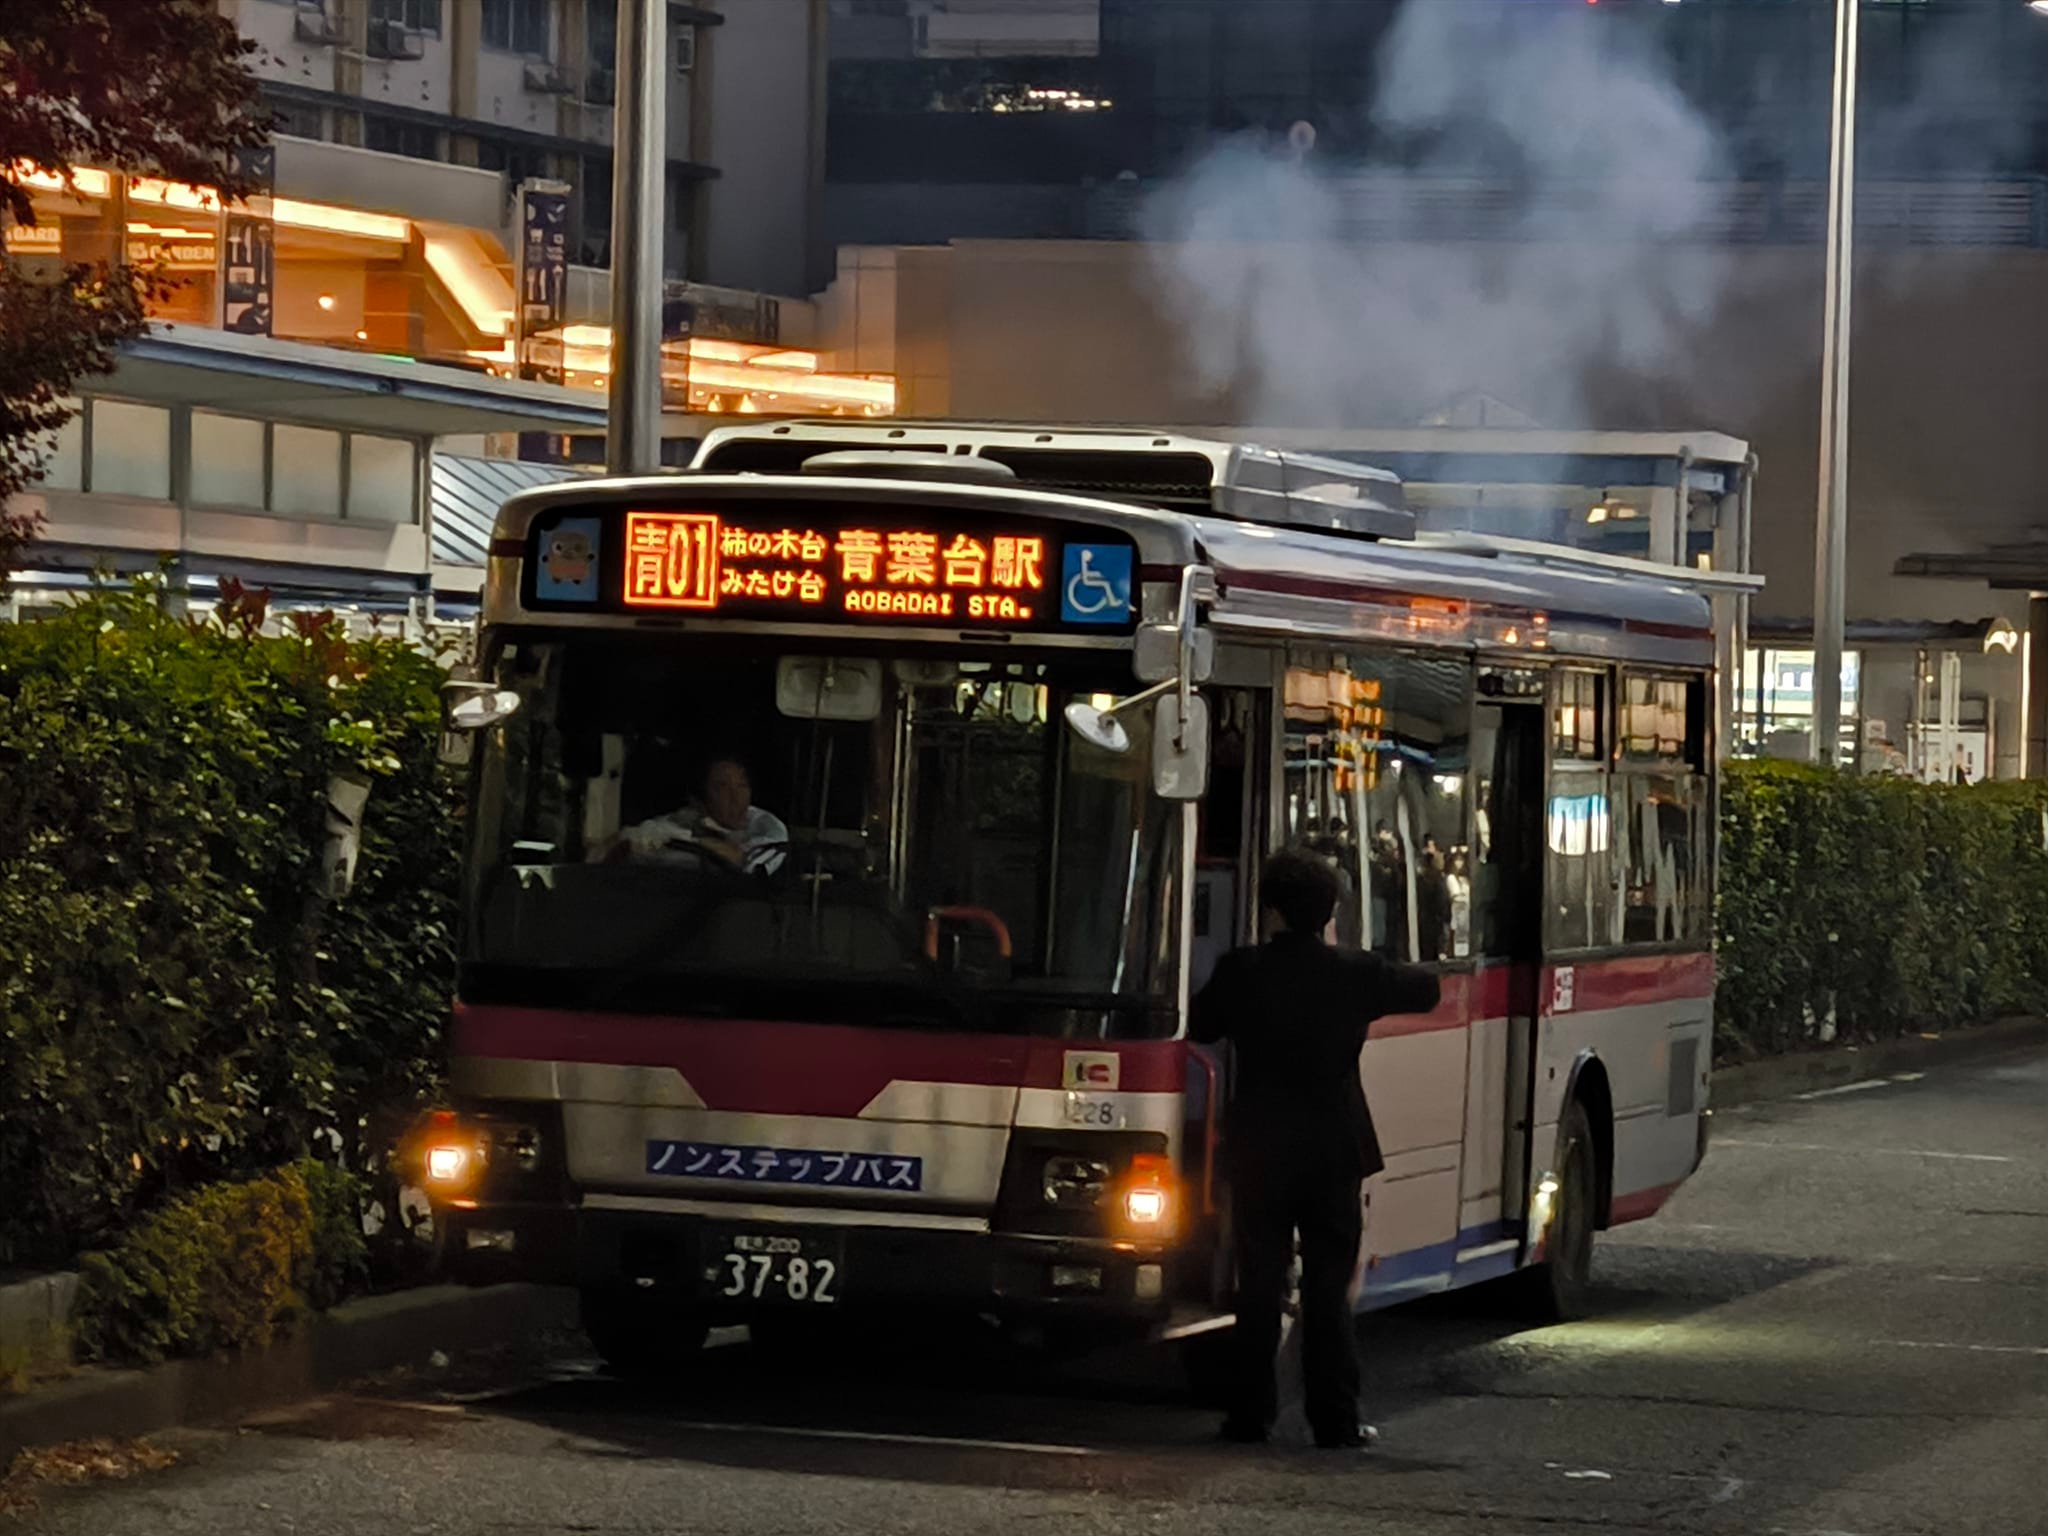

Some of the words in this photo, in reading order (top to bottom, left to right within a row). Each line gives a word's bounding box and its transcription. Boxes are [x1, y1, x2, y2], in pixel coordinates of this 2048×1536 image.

[631, 521, 708, 598] 青01
[720, 527, 827, 561] 柿の木台
[833, 529, 1044, 588] 青葉台駅
[719, 568, 826, 601] みたけ台
[844, 589, 953, 615] AOBADAI
[967, 594, 1032, 618] STA.
[652, 1144, 914, 1187] ノンステップバス
